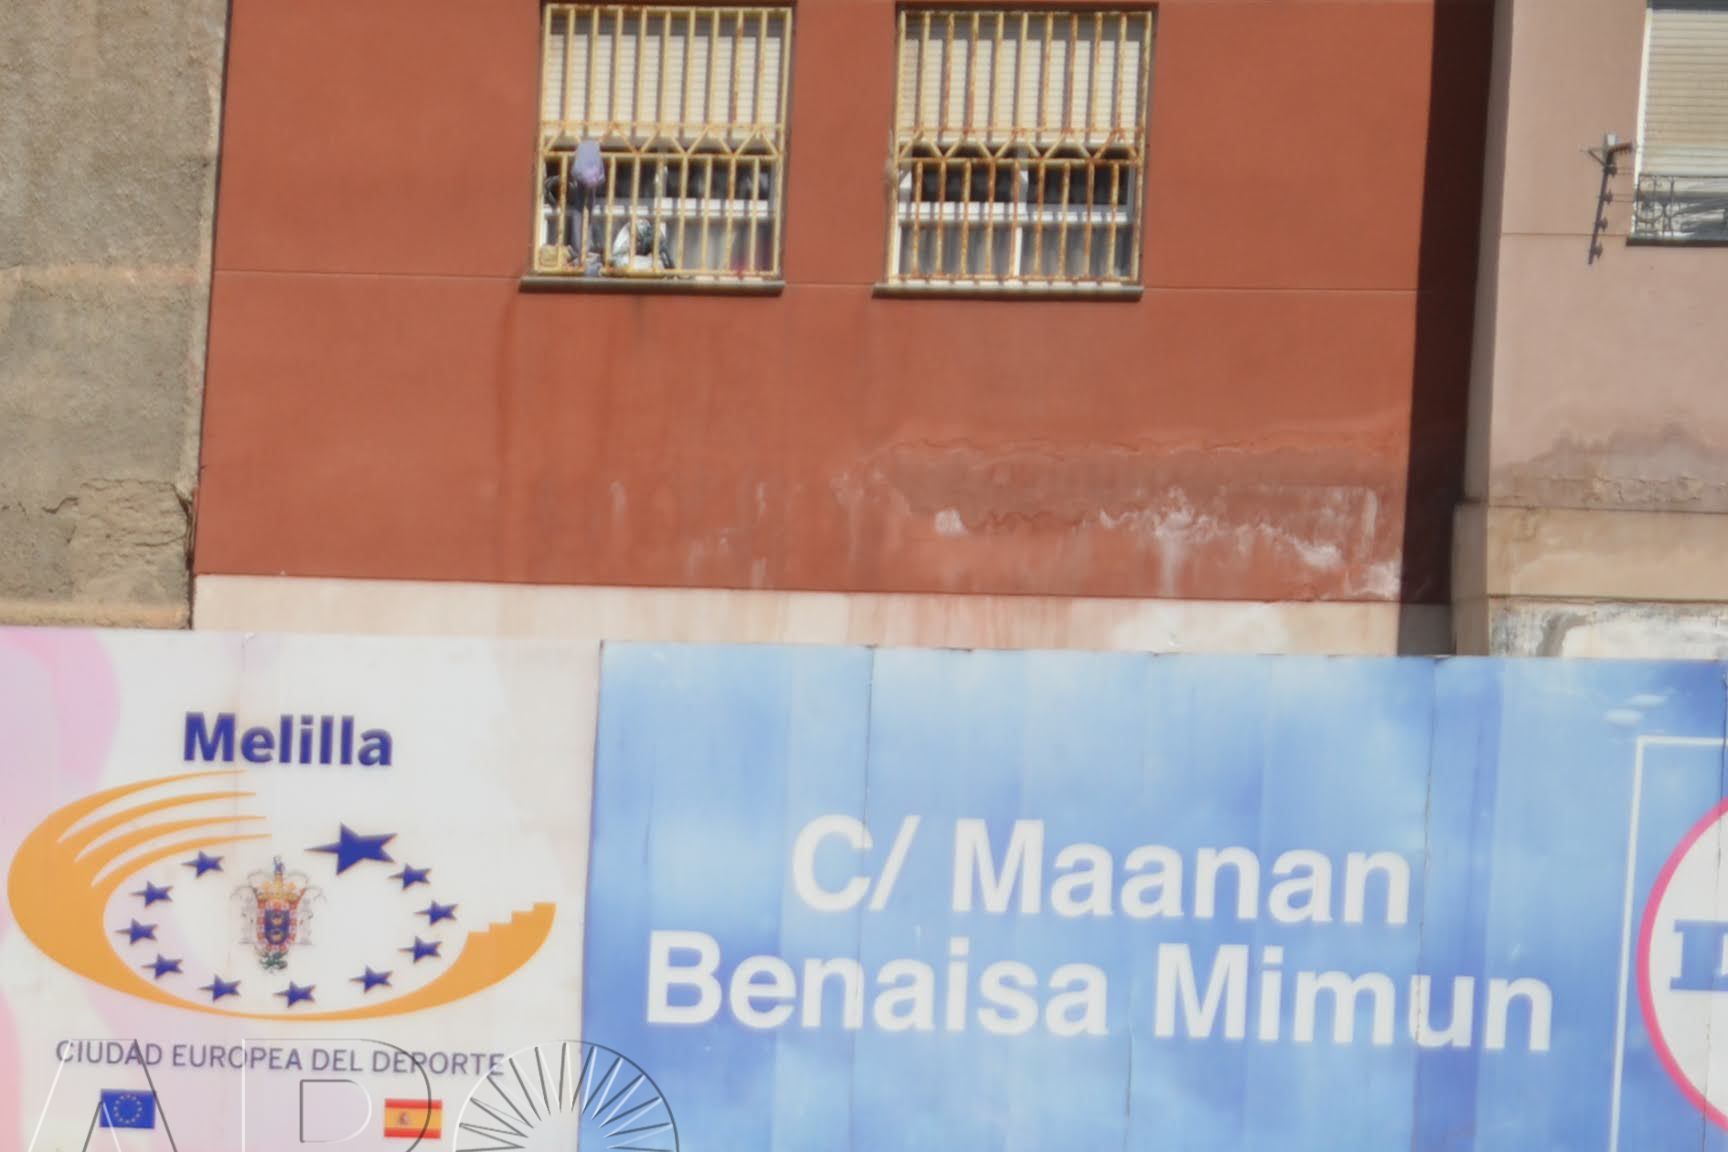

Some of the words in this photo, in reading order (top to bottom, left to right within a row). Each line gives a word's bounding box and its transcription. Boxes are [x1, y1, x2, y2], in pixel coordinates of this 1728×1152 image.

[182, 711, 395, 767] Melilla
[790, 812, 922, 914] C/
[951, 817, 1413, 926] Maanan
[645, 929, 1111, 1038] Benaisa
[1152, 940, 1554, 1053] Mimun
[55, 1039, 163, 1067] CIUDAD
[171, 1044, 304, 1072] EUROPEA
[311, 1048, 364, 1074] DEL
[371, 1049, 506, 1078] DEPORTE
